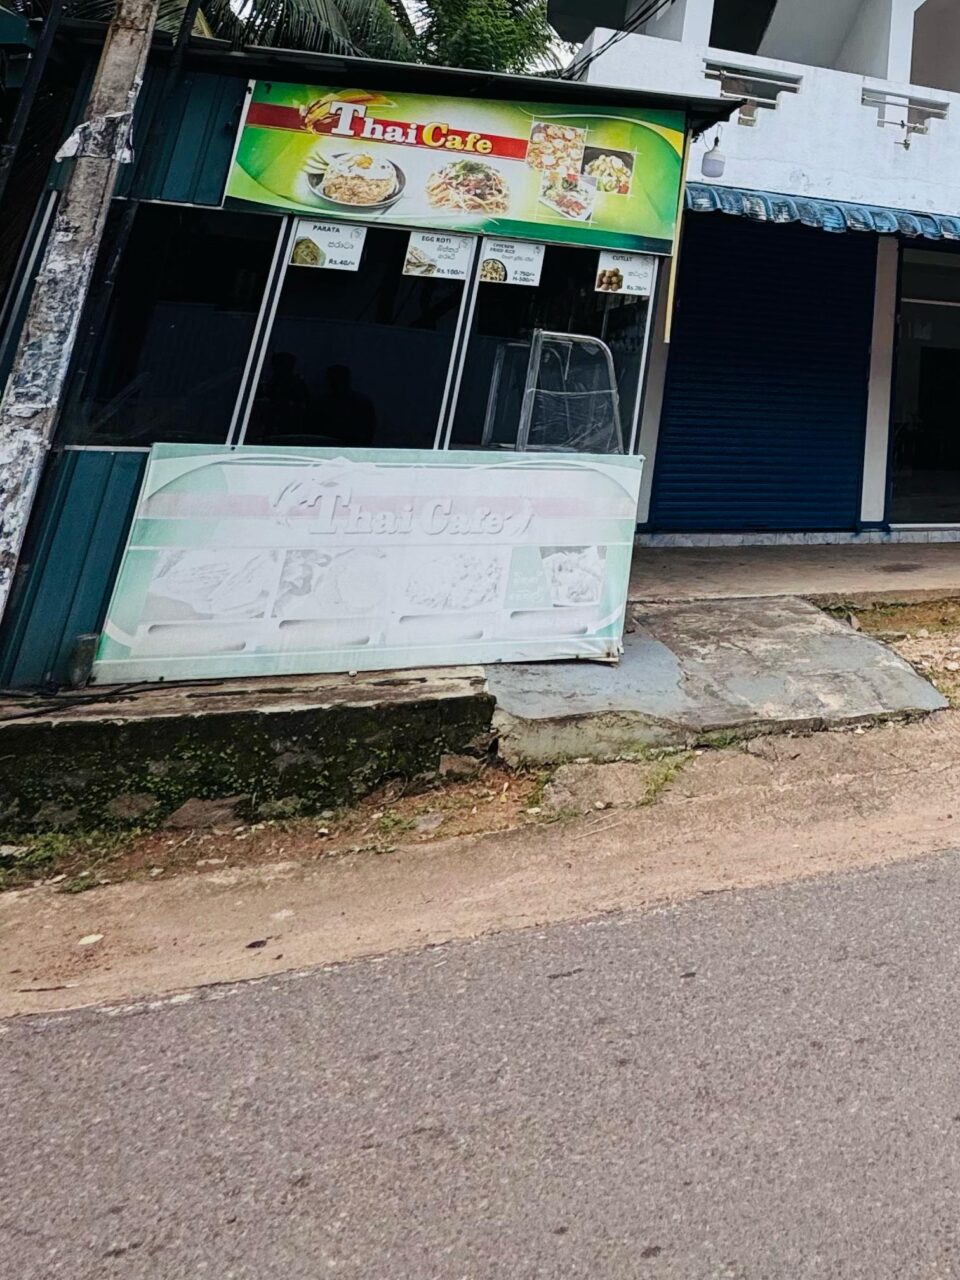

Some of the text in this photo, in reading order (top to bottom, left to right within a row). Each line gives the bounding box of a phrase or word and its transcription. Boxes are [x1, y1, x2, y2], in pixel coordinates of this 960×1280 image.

[329, 101, 494, 154] Thai Cafe
[307, 487, 414, 535] Thai
